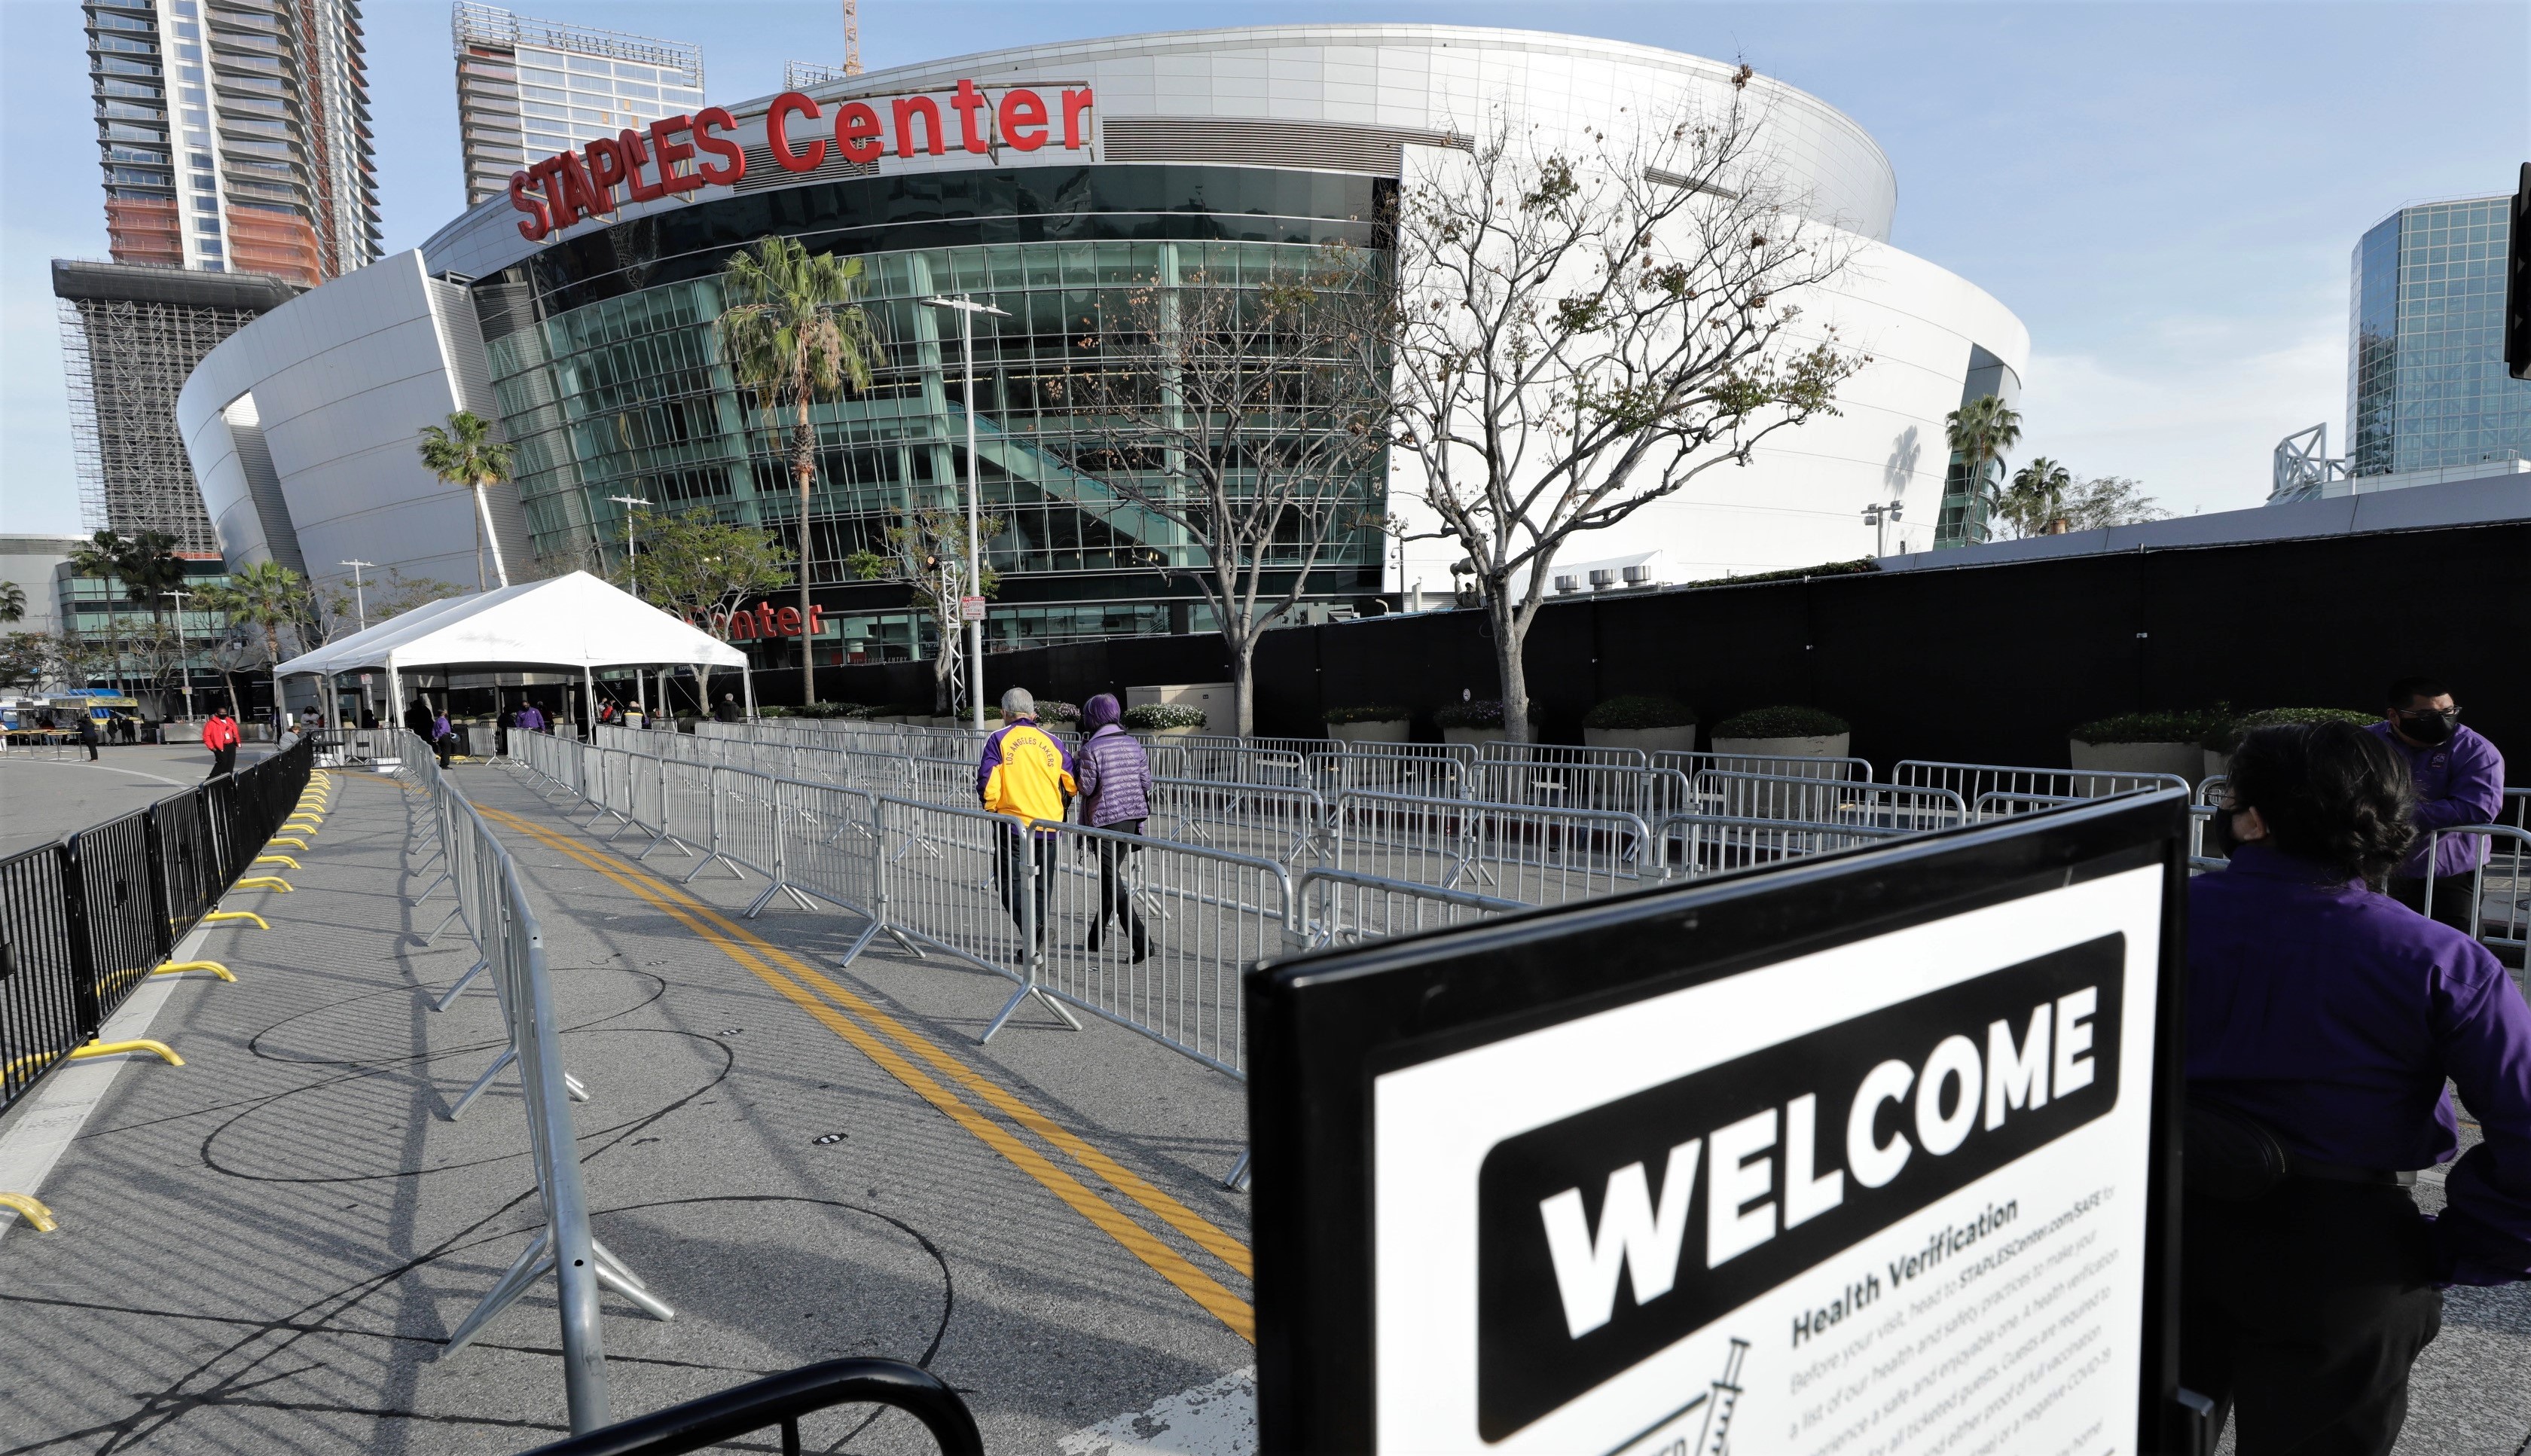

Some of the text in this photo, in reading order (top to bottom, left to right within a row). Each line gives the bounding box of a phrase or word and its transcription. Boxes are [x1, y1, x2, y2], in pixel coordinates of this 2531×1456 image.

[509, 79, 1094, 242] STAPLES Center
[1006, 737, 1055, 768] LOS ANGELES LAKERS
[1539, 986, 2097, 1341] WELCOME
[1790, 1198, 2018, 1349] Health Verification
[1790, 1229, 2097, 1439] a list of our health and safety practices to make your
[1791, 1354, 1839, 1394] Before
[1843, 1332, 1873, 1366] your
[1910, 1290, 1942, 1317] head
[1944, 1280, 1958, 1299] to
[1872, 1409, 1880, 1426] a
[1884, 1387, 1910, 1416] safe
[1913, 1367, 1937, 1396] and
[1940, 1329, 1996, 1378] enjoyable
[2033, 1282, 2065, 1312] health
[2067, 1248, 2119, 1290] verification
[1889, 1428, 1904, 1452] all
[1907, 1390, 1957, 1439] ticketed
[2001, 1335, 2038, 1370] Guests
[2041, 1323, 2057, 1345] are
[2059, 1292, 2099, 1328] required
[2101, 1286, 2111, 1302] to
[1948, 1412, 1983, 1448] either
[1985, 1383, 2016, 1423] proof
[2016, 1375, 2028, 1396] of
[2029, 1362, 2046, 1384] full
[2047, 1324, 2102, 1372] vaccination
[1999, 1425, 2010, 1445] or
[2023, 1384, 2066, 1420] negative
